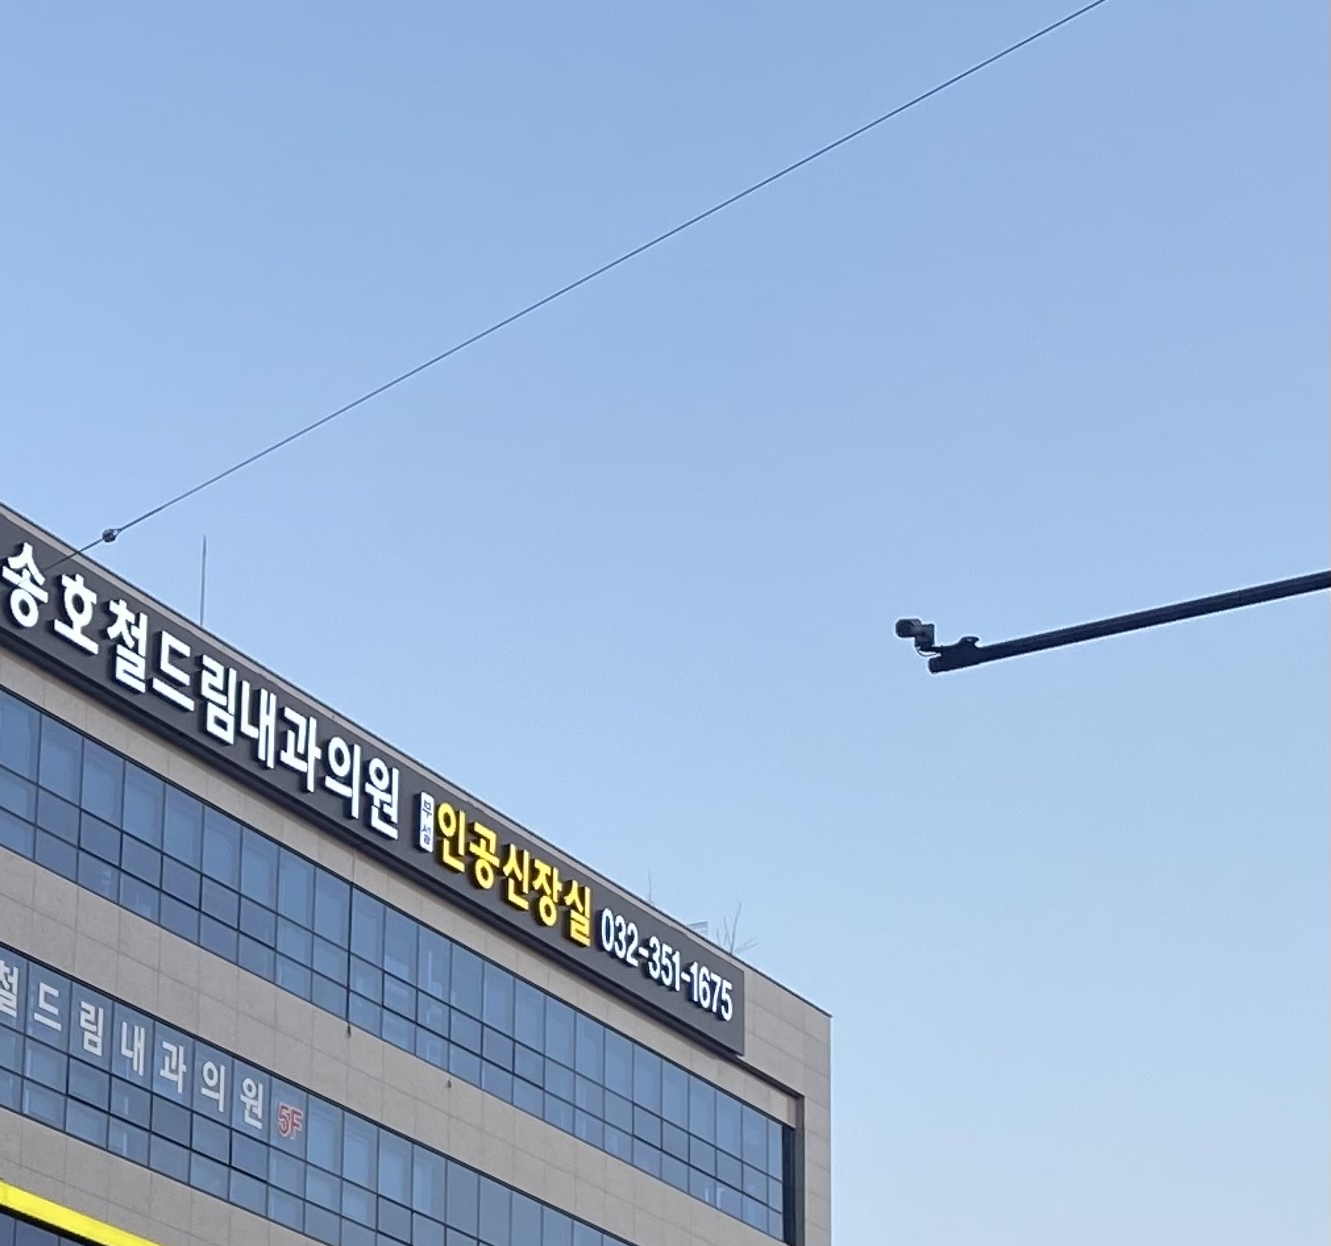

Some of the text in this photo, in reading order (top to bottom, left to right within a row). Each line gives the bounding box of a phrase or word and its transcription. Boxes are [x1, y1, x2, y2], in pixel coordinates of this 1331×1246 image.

[2, 542, 399, 840] 송호철드림내과의원
[437, 802, 591, 947] 인공신장실
[600, 907, 733, 1022] 032-351-1675
[276, 1101, 304, 1141] 5F
